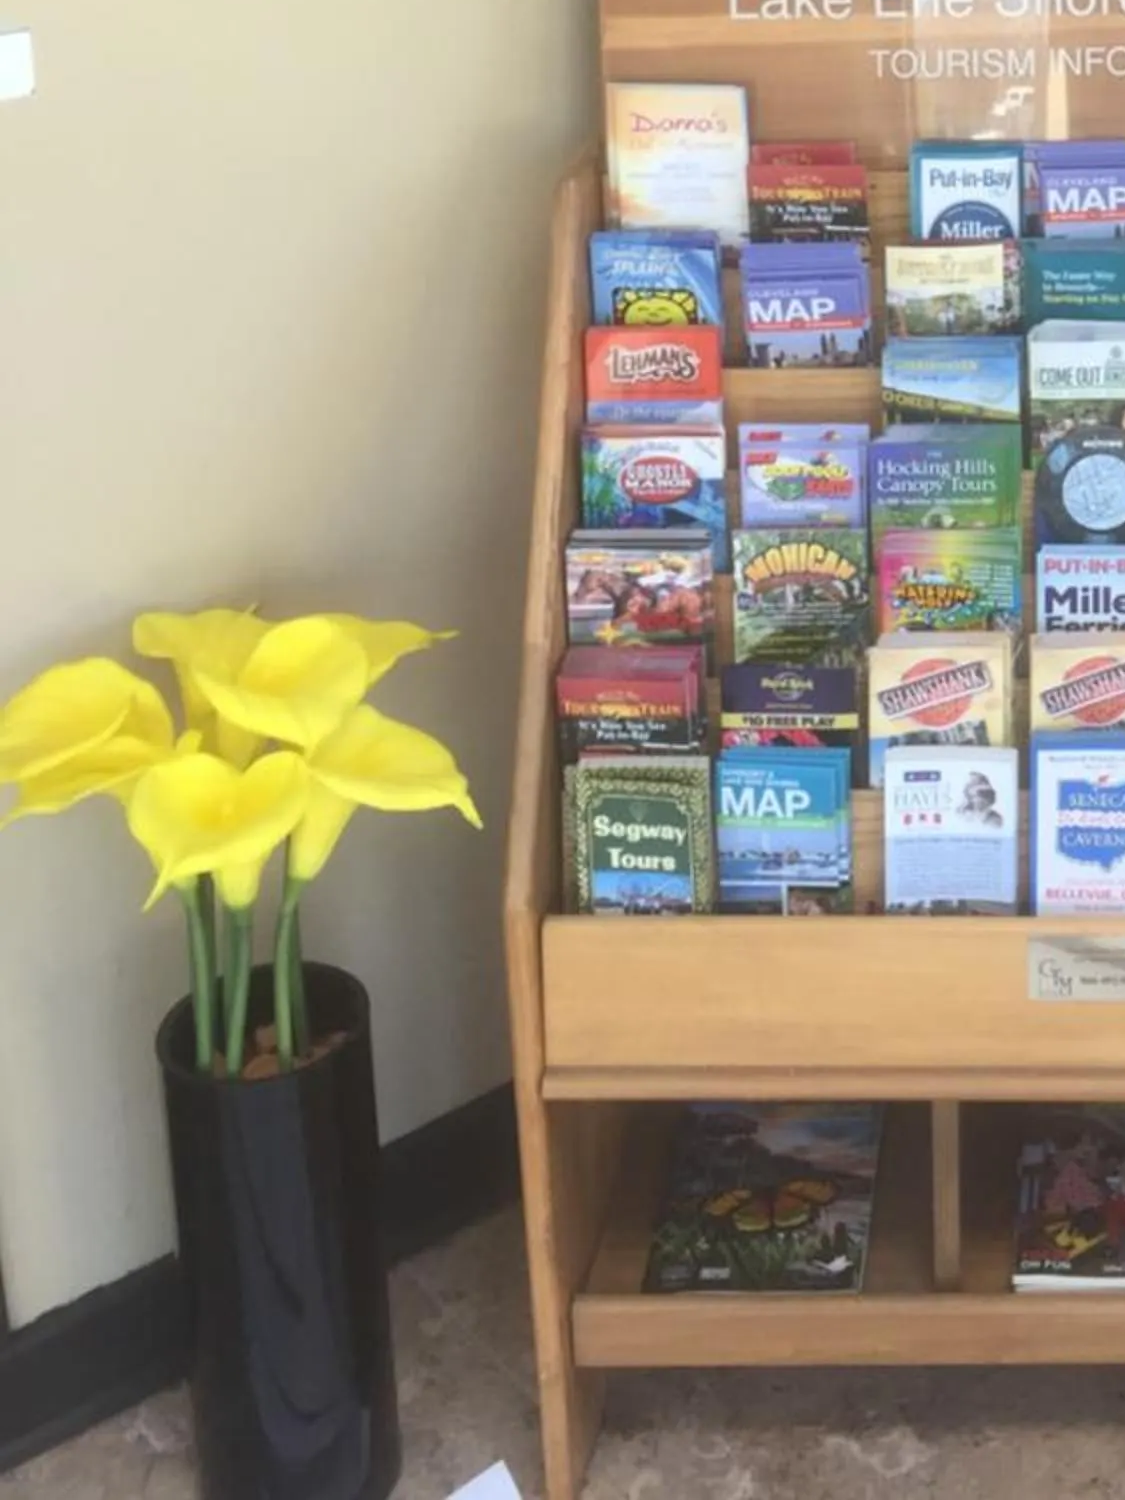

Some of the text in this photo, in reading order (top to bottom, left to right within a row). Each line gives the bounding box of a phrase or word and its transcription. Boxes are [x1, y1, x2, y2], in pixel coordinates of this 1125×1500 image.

[870, 48, 1035, 79] TOURISM
[929, 167, 1013, 191] Put-in-Bay
[939, 220, 1004, 240] Miller
[749, 297, 837, 324] MAP
[609, 344, 699, 382] LEHMAN'S
[1038, 368, 1074, 386] COME
[1075, 366, 1101, 385] OUT
[876, 458, 997, 479] Hocking Hills
[876, 476, 998, 496] Canopy Tours
[745, 541, 857, 583] MOHICAN
[881, 663, 989, 717] SHAWSHANK
[766, 716, 798, 727] FREE
[800, 716, 836, 727] PLAY
[721, 786, 812, 819] MAP
[593, 814, 688, 847] Segway
[607, 847, 676, 871] Tours
[1045, 888, 1117, 902] BELLEVUE,
